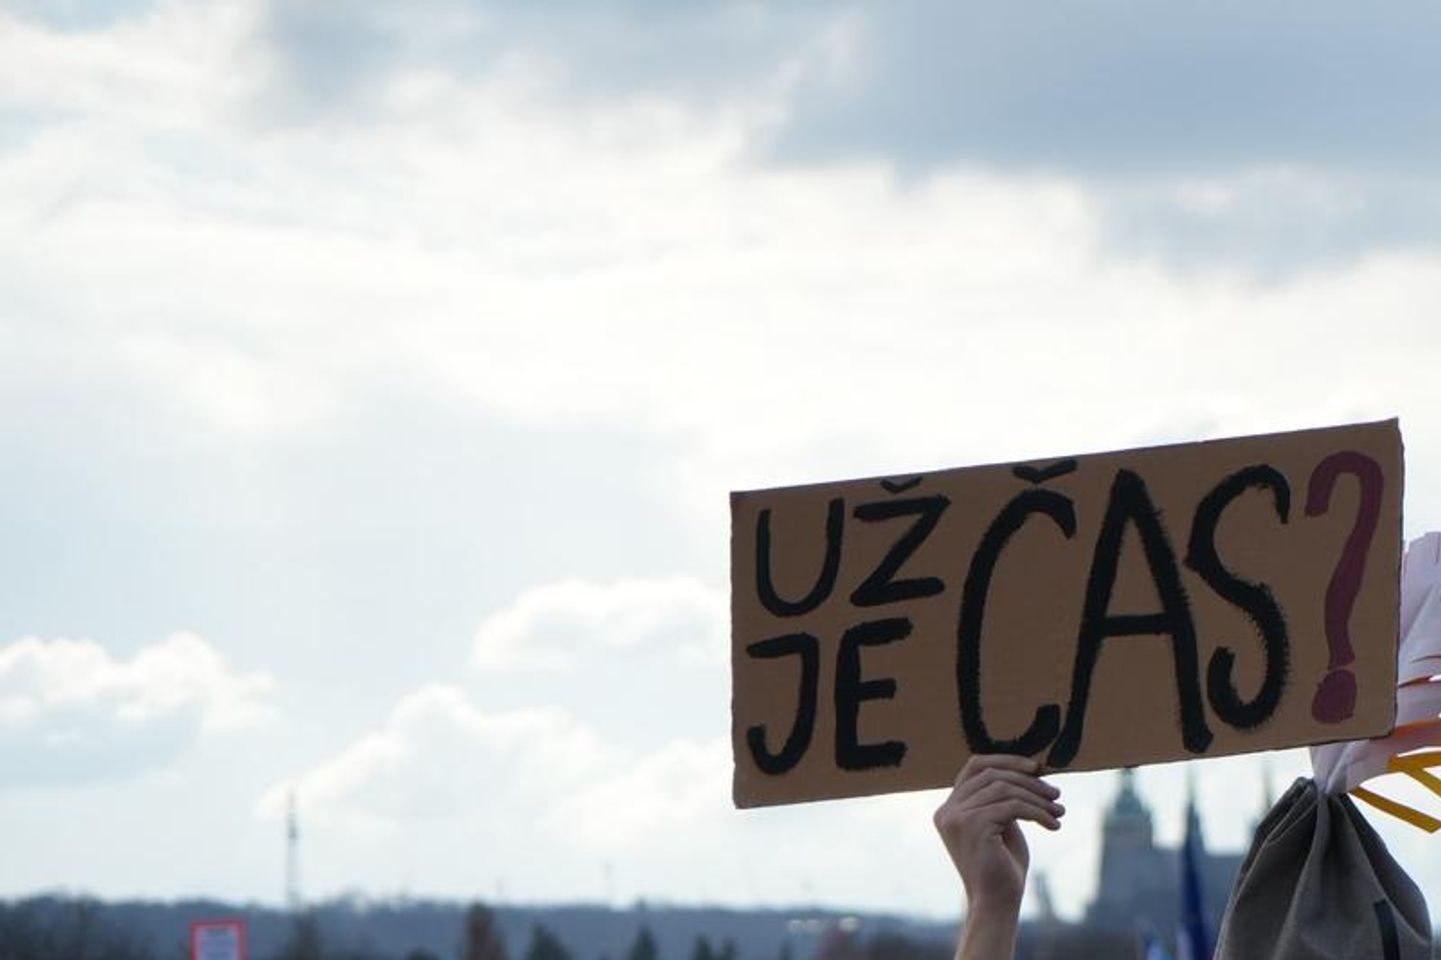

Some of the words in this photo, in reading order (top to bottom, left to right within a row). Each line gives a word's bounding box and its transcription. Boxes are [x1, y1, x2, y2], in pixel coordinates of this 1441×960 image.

[746, 616, 914, 775] JE
[754, 476, 951, 618] UŽ
[957, 450, 1385, 769] ČAS?
